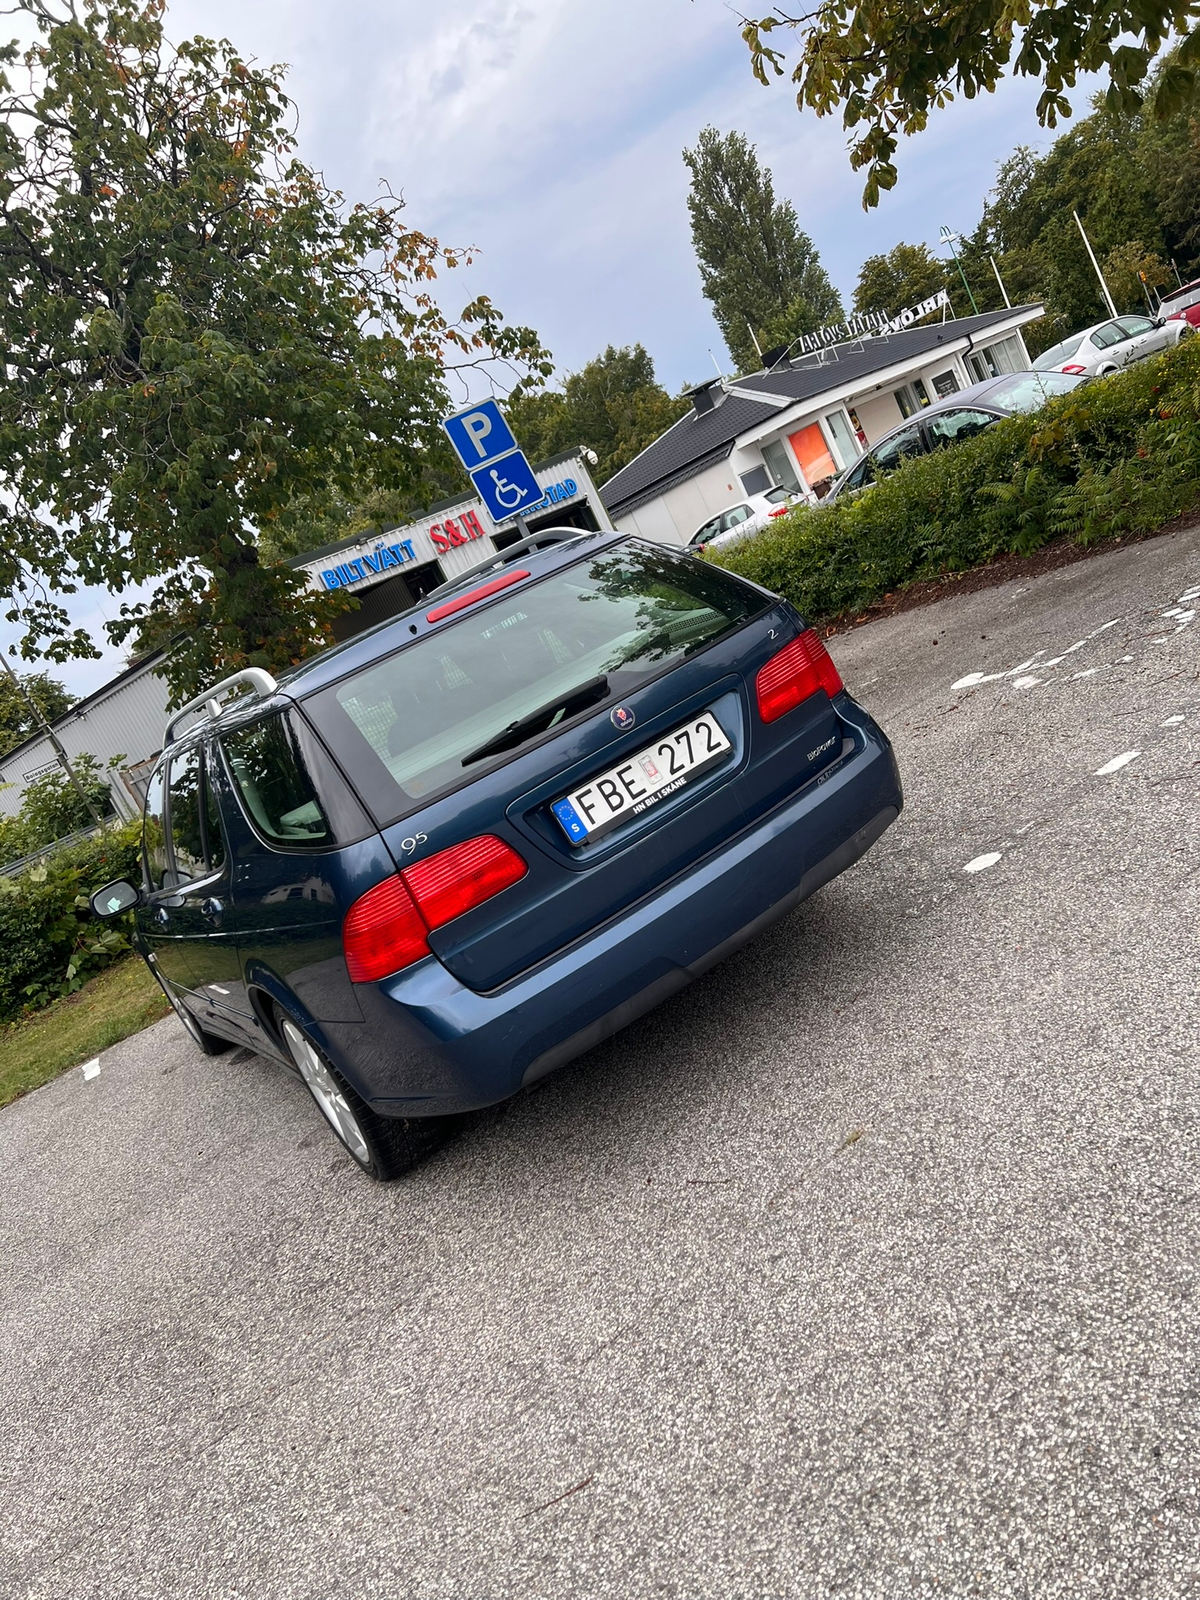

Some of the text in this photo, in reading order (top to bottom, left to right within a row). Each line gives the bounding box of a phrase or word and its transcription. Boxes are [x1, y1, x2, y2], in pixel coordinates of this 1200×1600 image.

[460, 411, 492, 458] P
[320, 538, 417, 590] BILTVÄTT
[428, 509, 486, 554] S&H
[575, 721, 722, 825] FBE 272
[632, 802, 646, 815] HN
[645, 794, 659, 808] BIL
[661, 776, 688, 798] SKÅNE
[400, 830, 428, 856] 95
[571, 823, 580, 833] S
